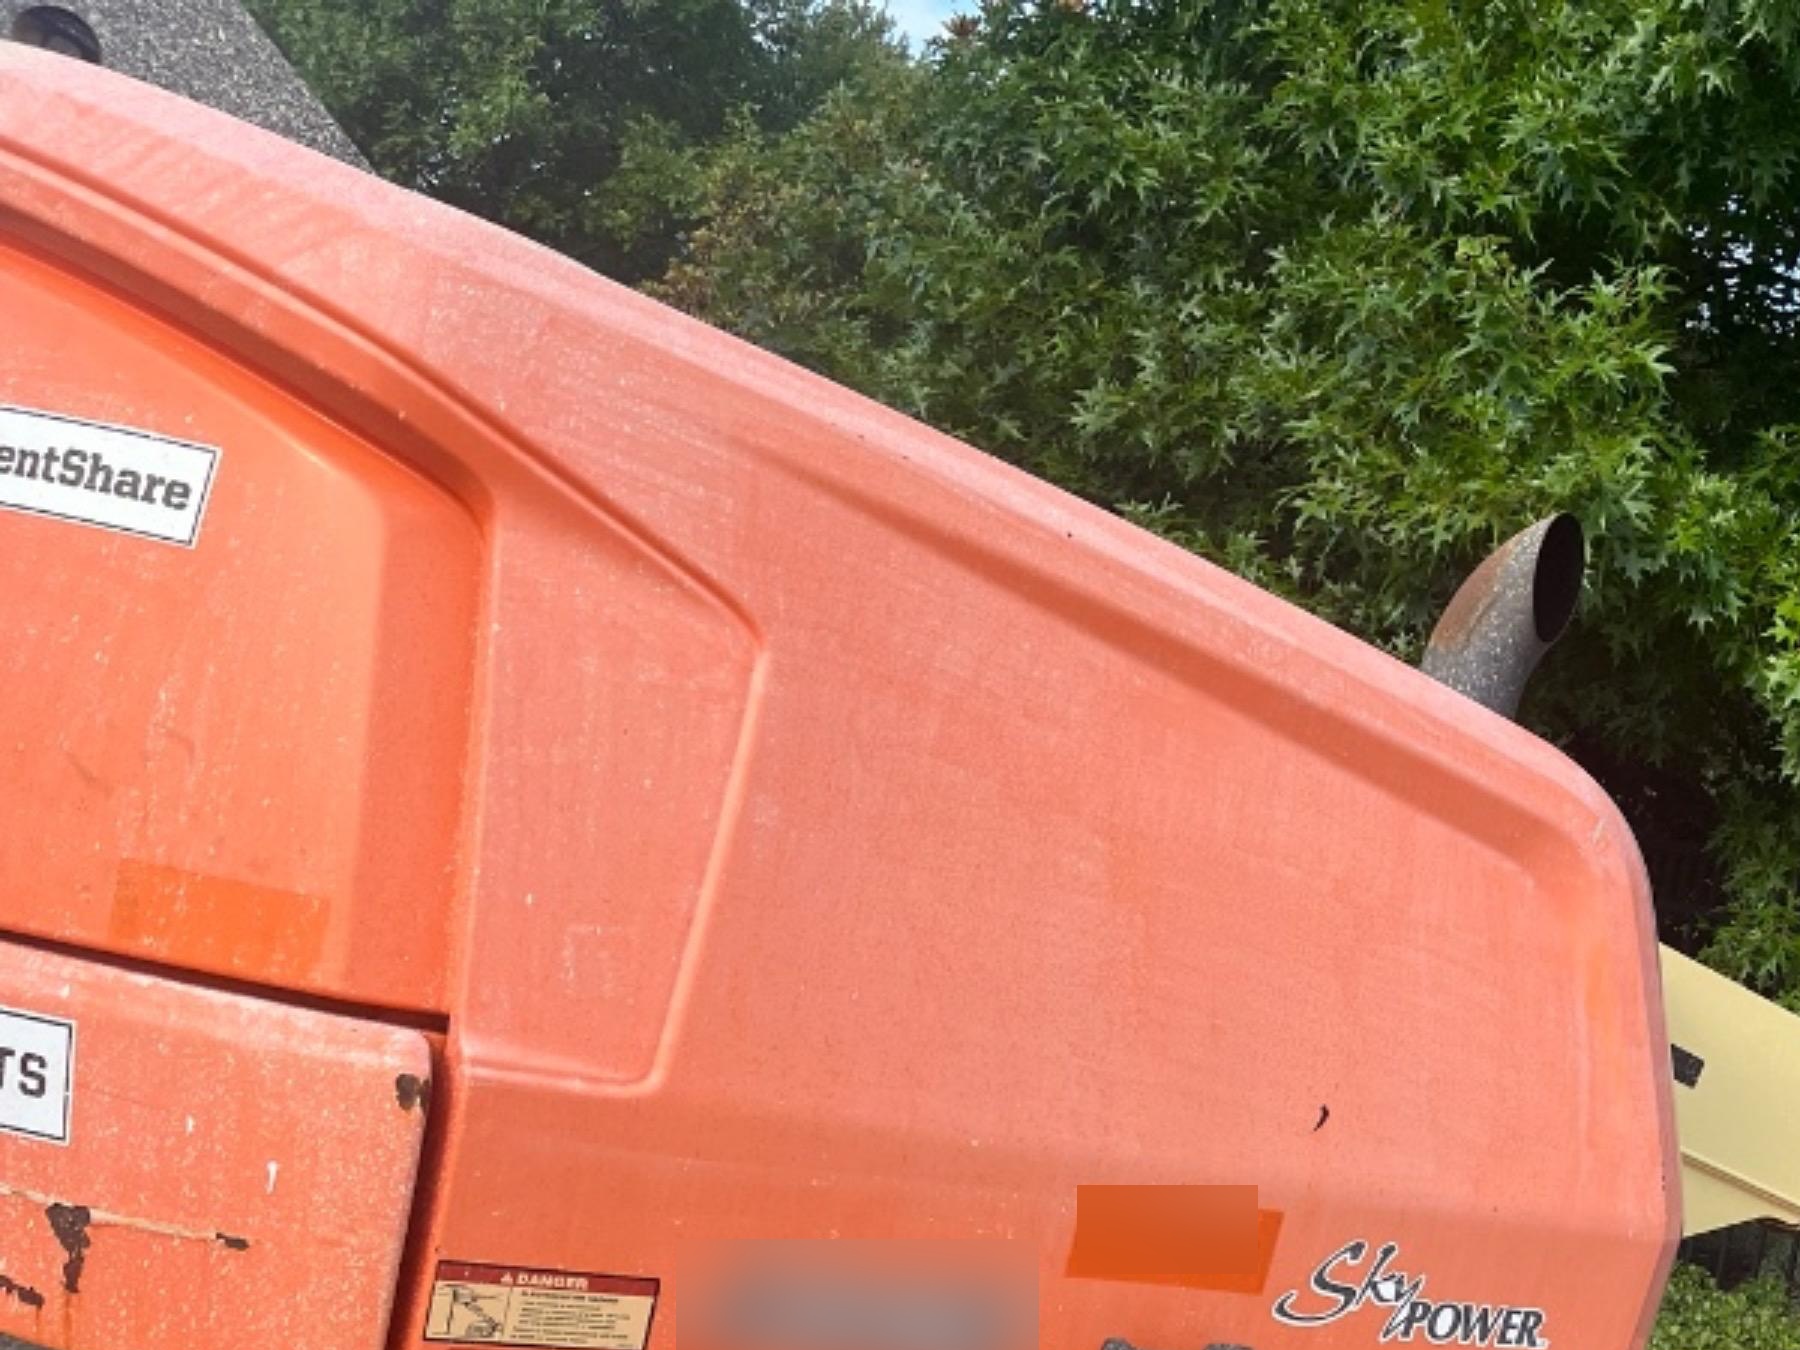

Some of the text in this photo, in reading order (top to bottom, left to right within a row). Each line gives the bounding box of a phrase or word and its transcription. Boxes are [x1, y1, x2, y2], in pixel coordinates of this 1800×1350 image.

[516, 1274, 590, 1291] DANGER
[1272, 1240, 1424, 1341] Sky
[1400, 1299, 1545, 1348] POWER
